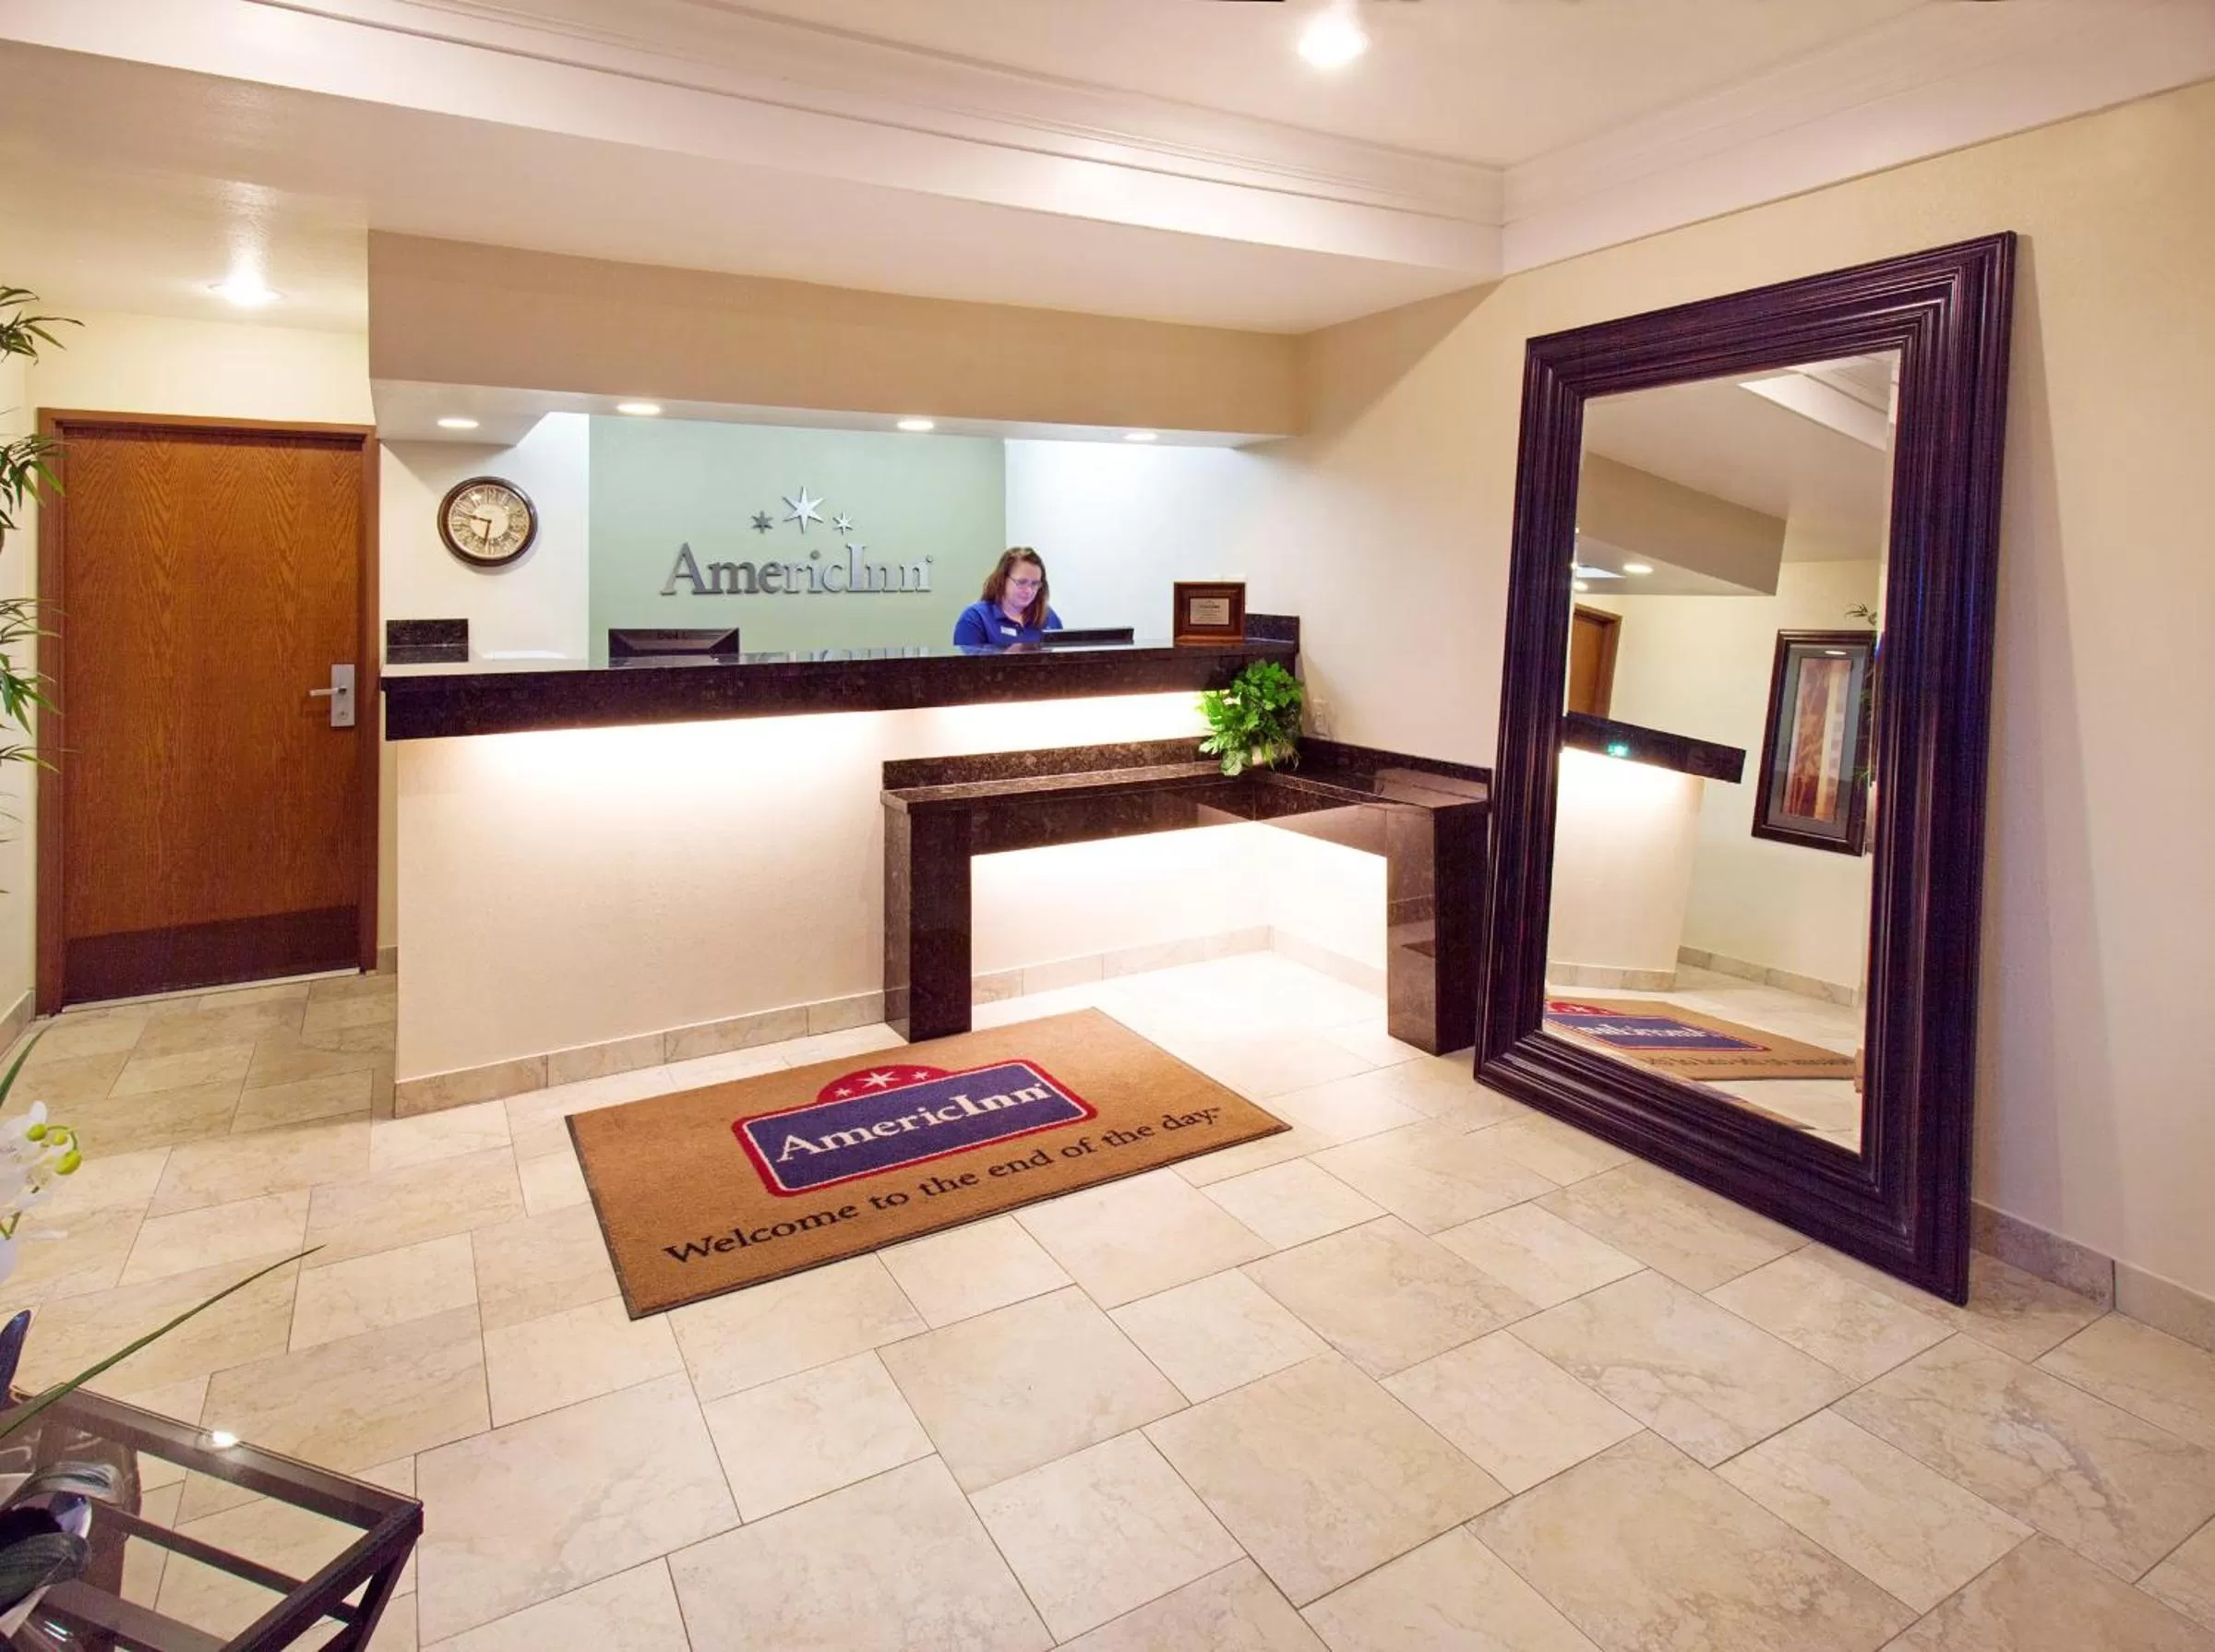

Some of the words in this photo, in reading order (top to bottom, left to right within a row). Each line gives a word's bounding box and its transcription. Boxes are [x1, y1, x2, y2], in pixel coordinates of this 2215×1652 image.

[659, 542, 933, 595] AmericInn
[776, 1083, 1053, 1163] AmericInn
[663, 1203, 860, 1263] Welcome
[868, 1191, 910, 1211] to
[918, 1177, 980, 1197] the
[988, 1149, 1055, 1178] end
[1060, 1137, 1099, 1158] of
[1101, 1126, 1155, 1148] the
